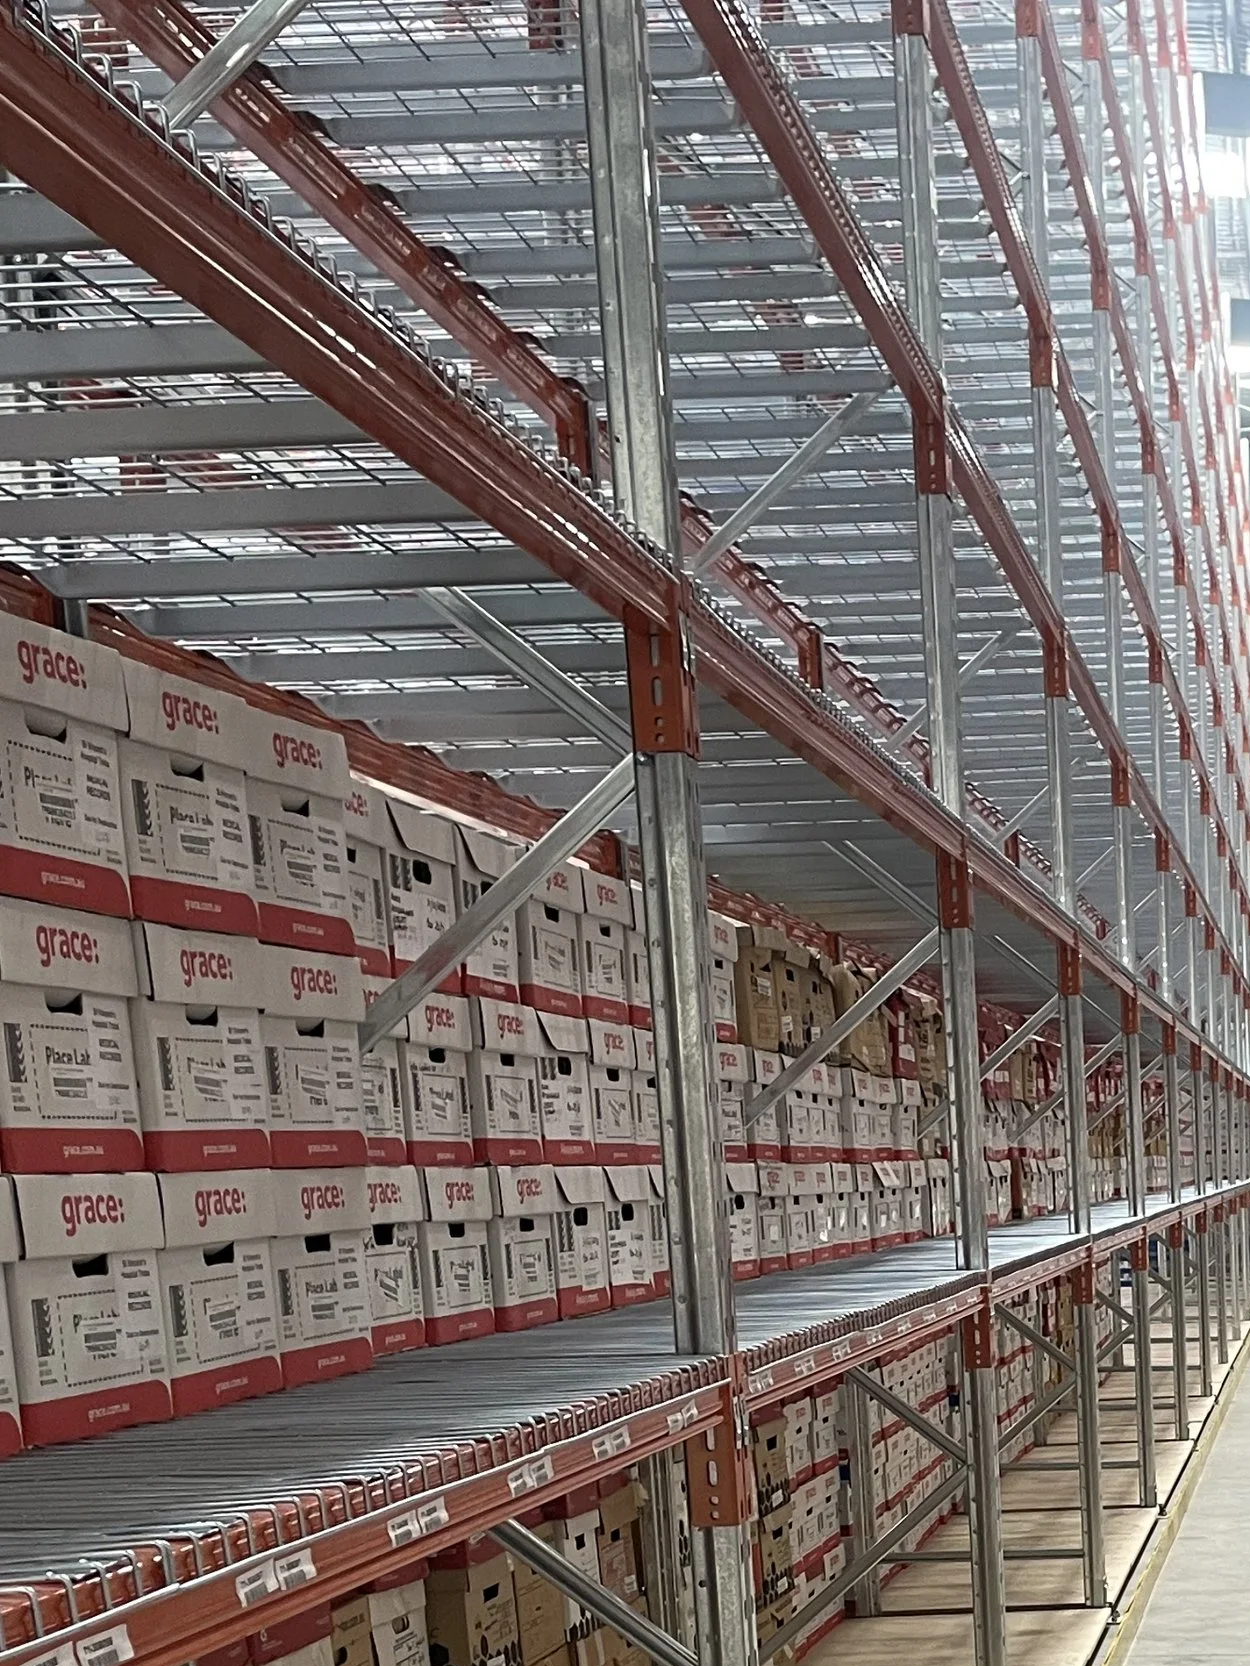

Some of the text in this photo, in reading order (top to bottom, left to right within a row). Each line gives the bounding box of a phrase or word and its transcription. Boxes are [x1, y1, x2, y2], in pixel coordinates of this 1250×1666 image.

[17, 639, 87, 690] grace:
[161, 690, 219, 735] grace:
[272, 731, 322, 770] grace:
[35, 924, 100, 968] grace:
[180, 948, 234, 988] grace:
[290, 965, 339, 1001] grace:
[60, 1193, 126, 1238] grace:
[194, 1186, 248, 1229] grace:
[300, 1183, 346, 1221] grace:
